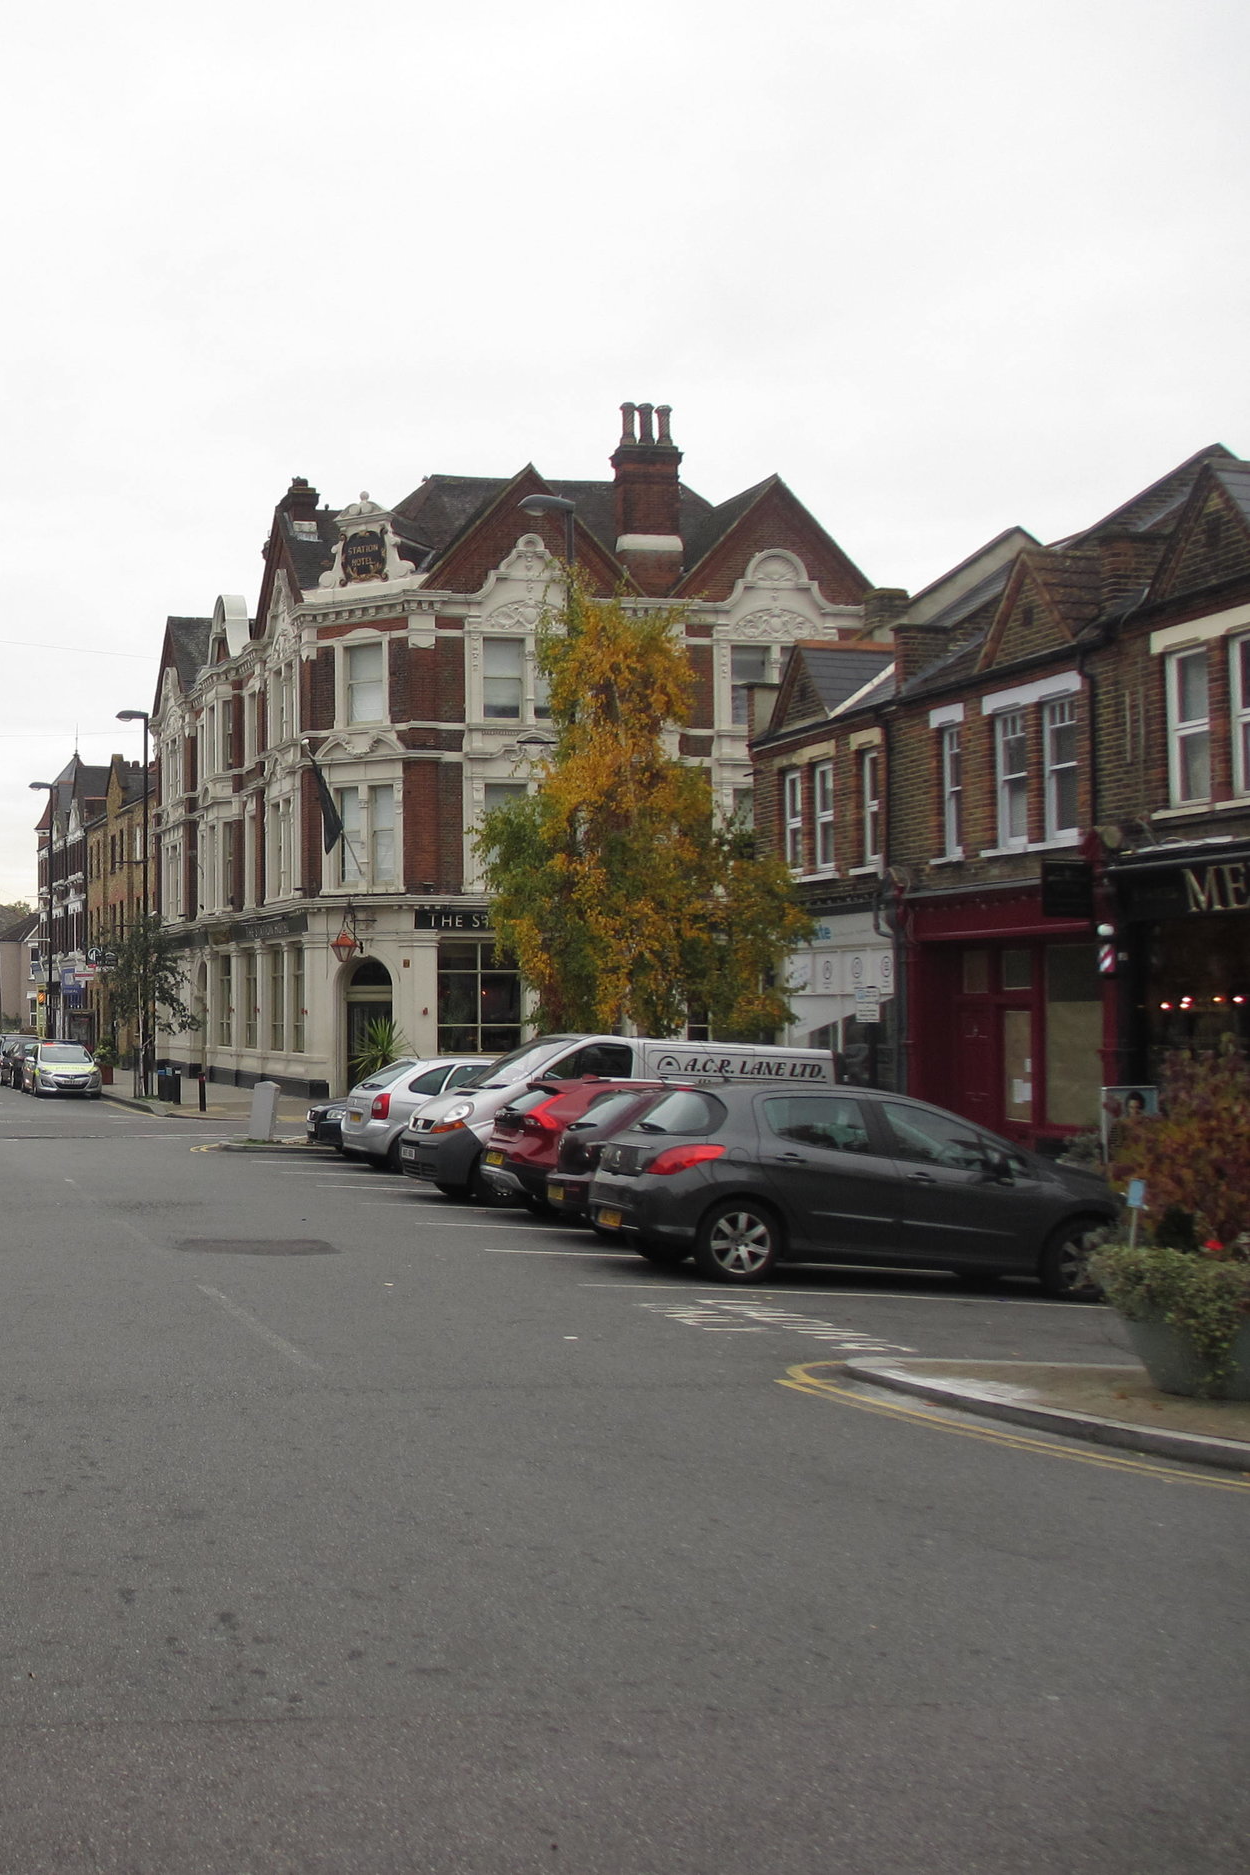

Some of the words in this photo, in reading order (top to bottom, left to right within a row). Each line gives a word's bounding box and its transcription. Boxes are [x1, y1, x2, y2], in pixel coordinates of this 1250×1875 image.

[348, 544, 379, 554] STATION
[351, 557, 375, 566] HOTEL
[428, 914, 463, 927] THE
[684, 1058, 734, 1074] A.C.R.
[740, 1060, 786, 1077] LANE
[789, 1063, 826, 1079] LTD.
